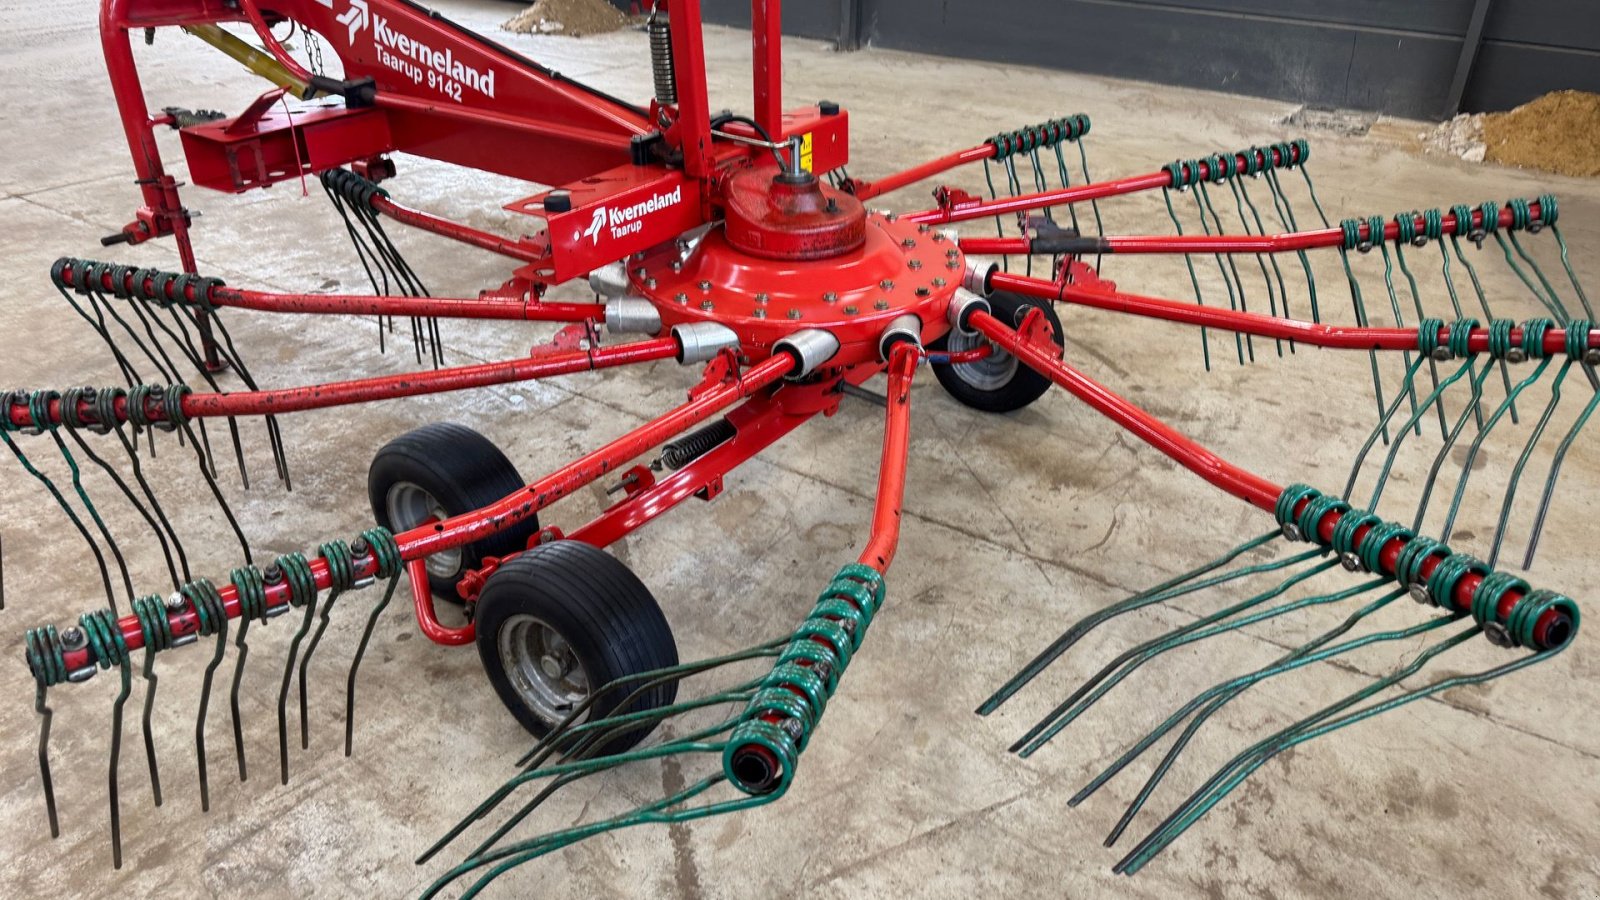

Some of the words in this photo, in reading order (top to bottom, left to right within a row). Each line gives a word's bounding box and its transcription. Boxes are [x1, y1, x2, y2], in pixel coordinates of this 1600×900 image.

[373, 13, 495, 98] Kverneland
[374, 43, 423, 85] Taarup
[428, 73, 462, 103] 9142
[609, 185, 681, 227] Kverneland
[611, 220, 642, 240] Taarup
